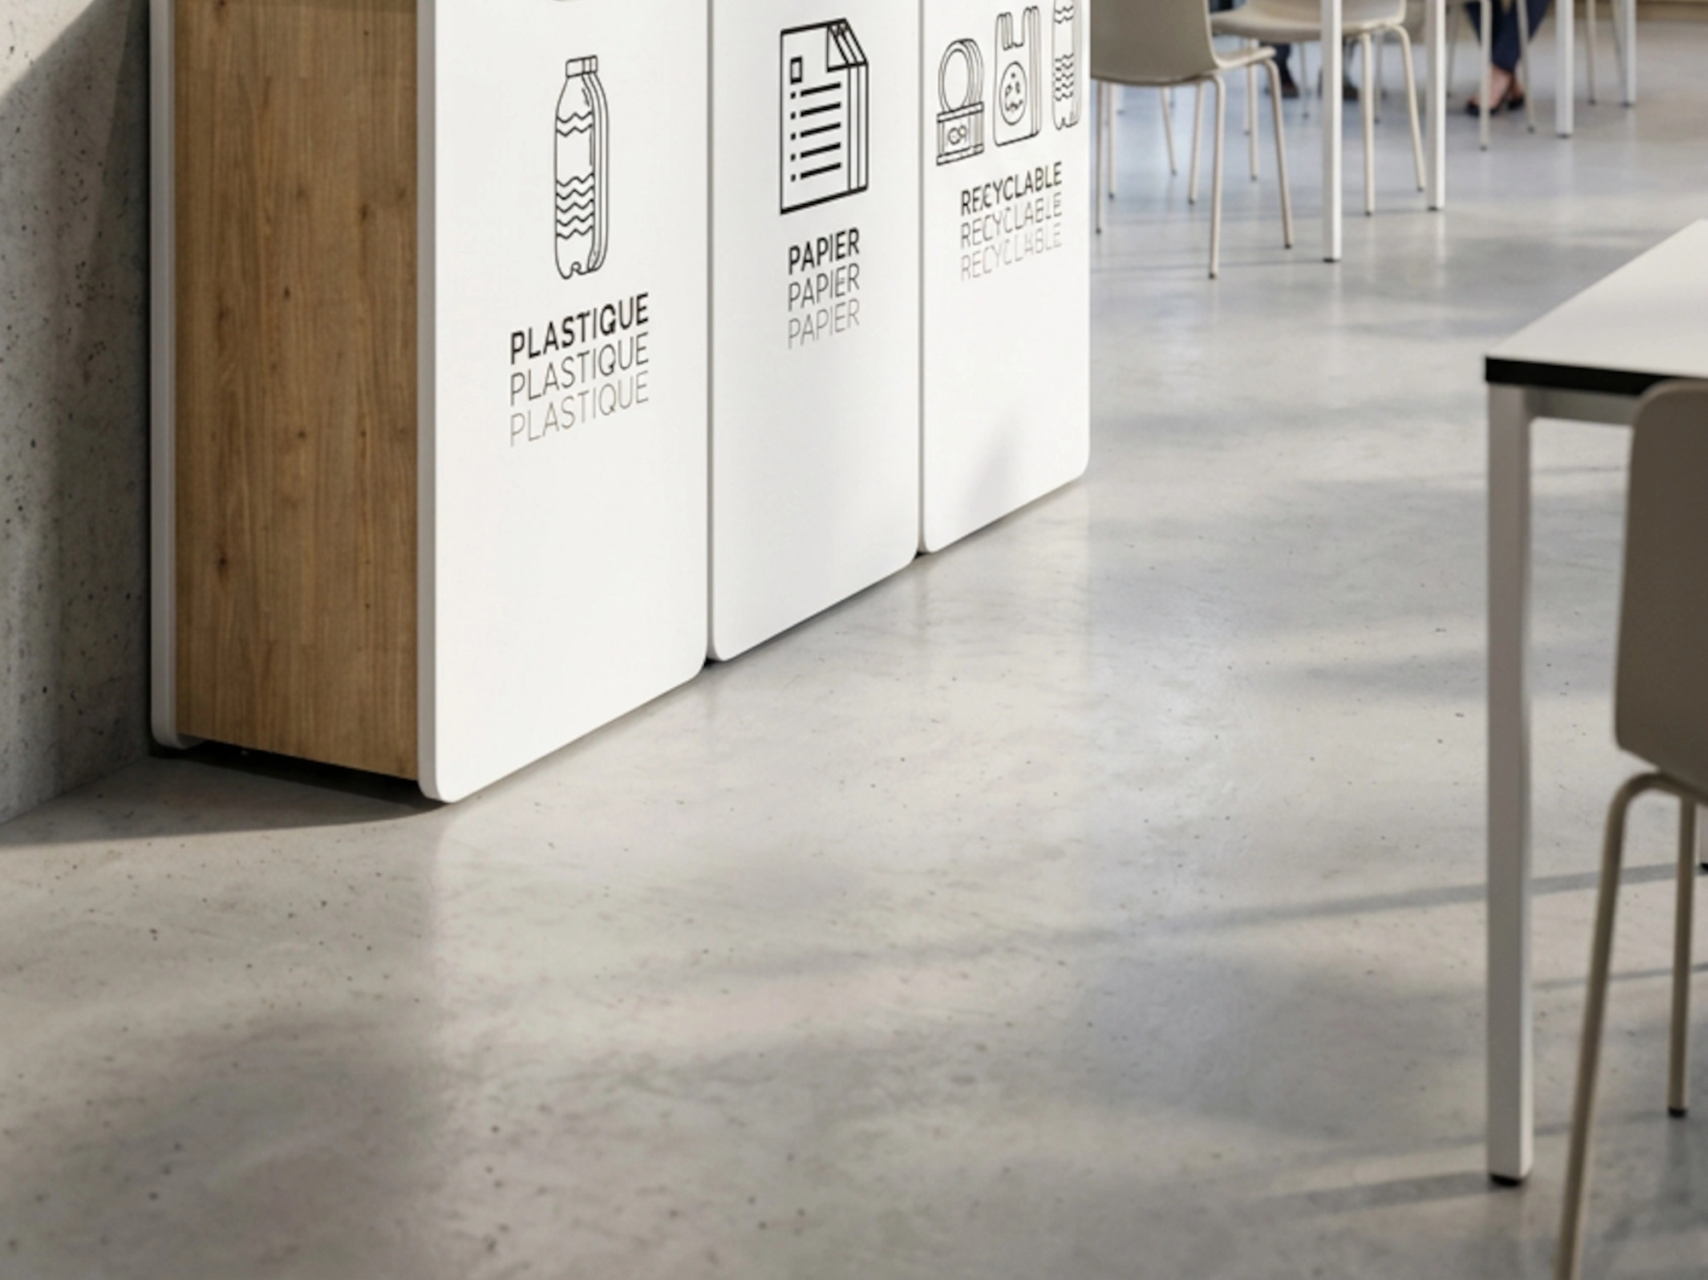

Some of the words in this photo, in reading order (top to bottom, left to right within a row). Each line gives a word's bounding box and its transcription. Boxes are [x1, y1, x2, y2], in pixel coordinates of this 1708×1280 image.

[961, 161, 1062, 217] RECYCLABLE
[788, 227, 860, 275] PAPIER
[788, 262, 860, 312] PAPIER
[510, 291, 648, 365] PLASTIQUE
[788, 297, 860, 350] PAPIER
[510, 331, 648, 407] PLASTIQUE
[510, 370, 648, 447] PLASTIQUE
